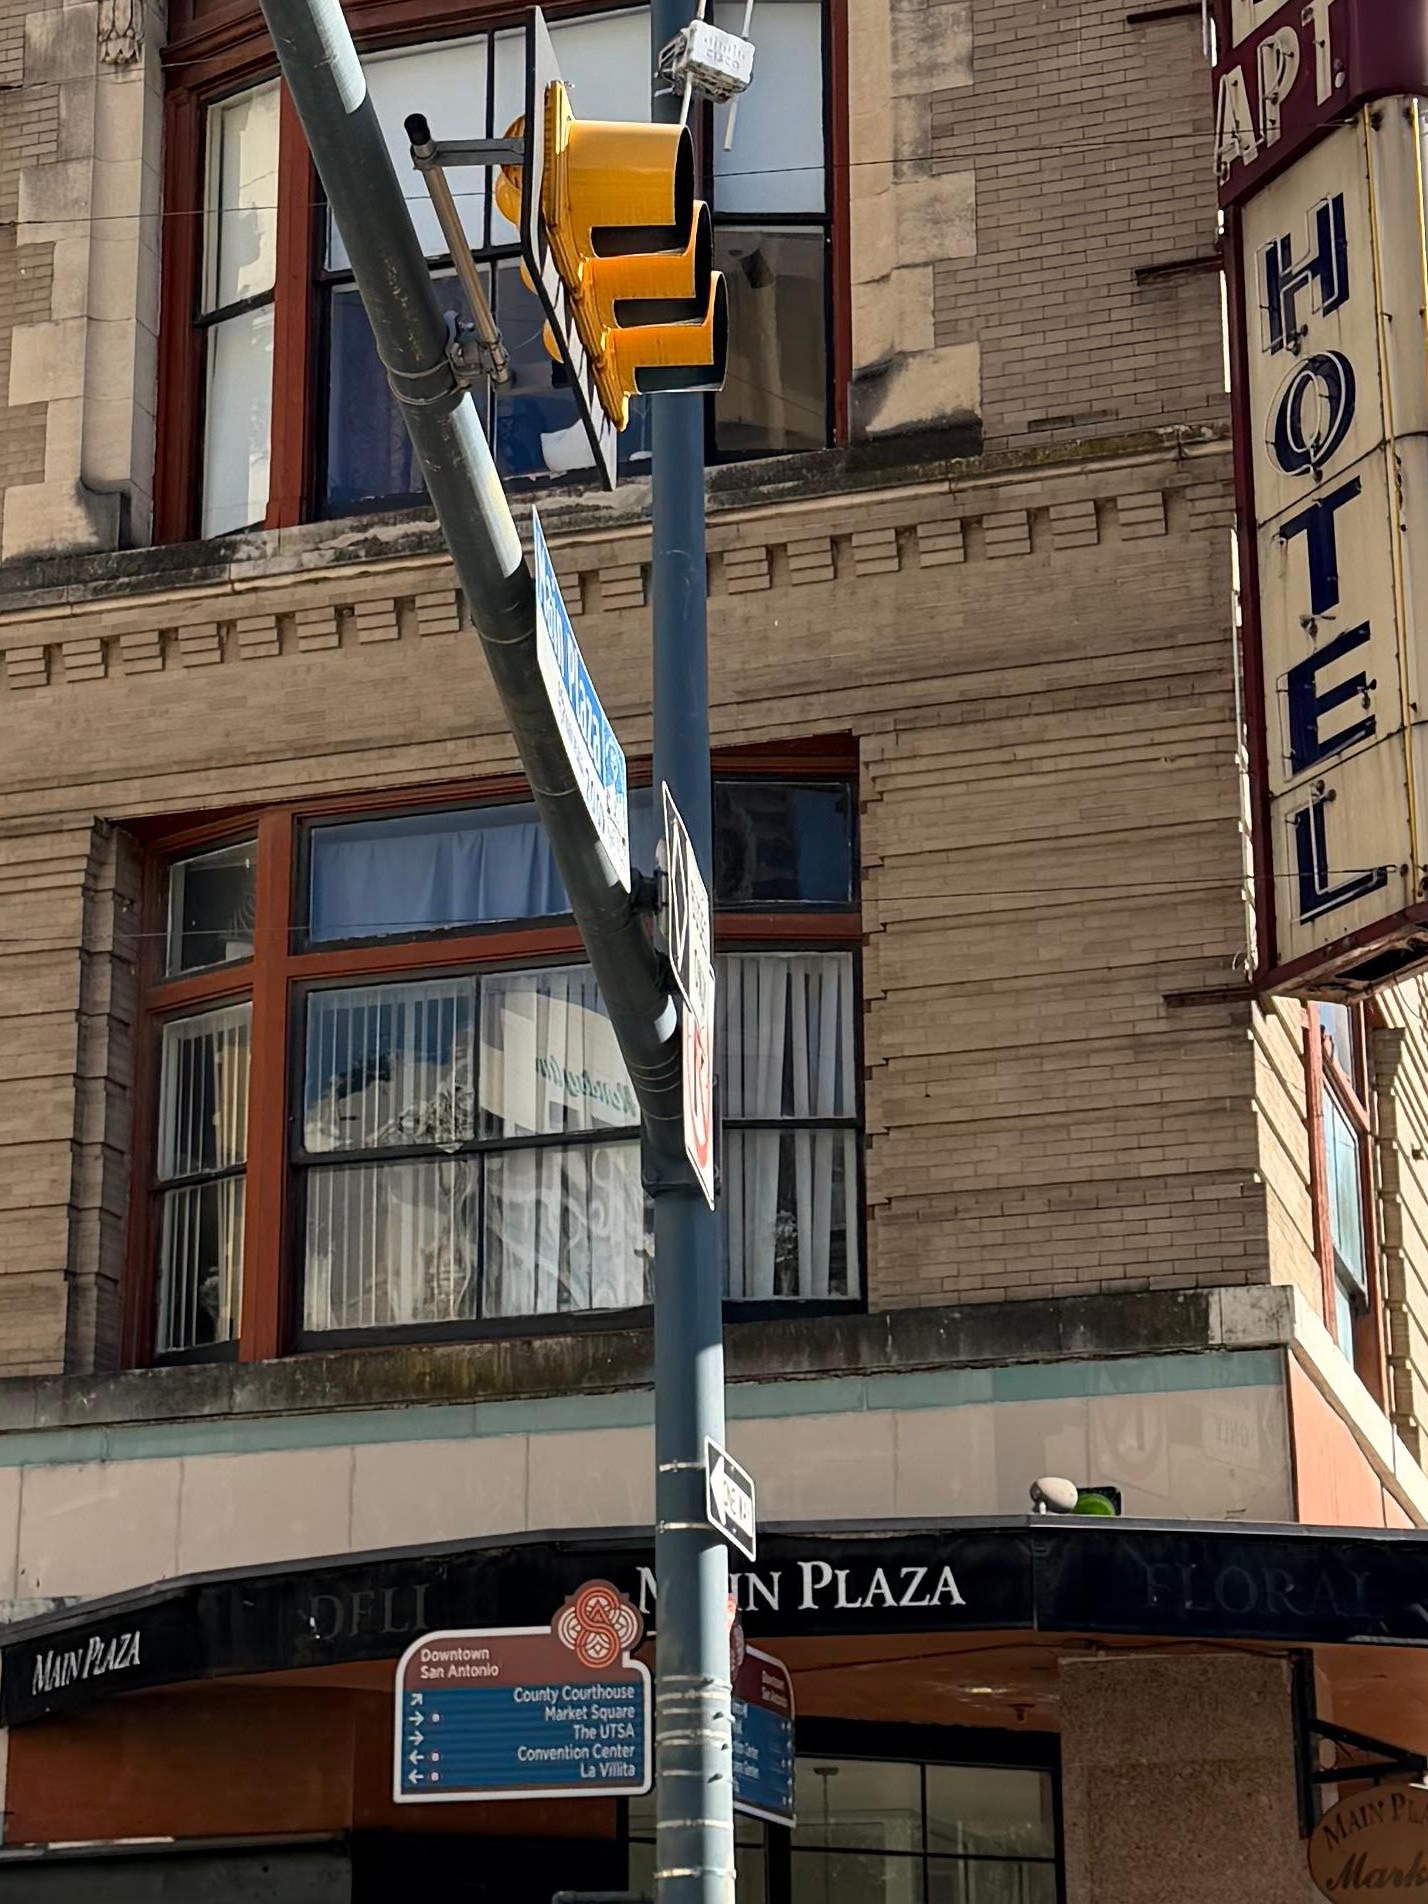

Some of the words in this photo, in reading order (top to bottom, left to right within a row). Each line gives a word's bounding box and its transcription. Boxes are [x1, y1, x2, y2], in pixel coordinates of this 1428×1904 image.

[1256, 191, 1389, 925] HOTEL
[537, 538, 564, 679] Main
[566, 632, 602, 774] Plaza
[797, 1560, 967, 1610] PLAZA
[32, 1649, 83, 1696] MAIN
[82, 1630, 141, 1679] PLAZA
[420, 1648, 490, 1663] Downtown
[420, 1665, 445, 1680] San
[452, 1663, 500, 1678] Antonio
[513, 1687, 559, 1704] County
[561, 1684, 635, 1701] Courthouse
[545, 1706, 588, 1722] Market
[591, 1704, 635, 1721] Square
[573, 1724, 598, 1740] The
[599, 1723, 635, 1739] UTSA
[517, 1746, 590, 1762] Convention
[592, 1744, 635, 1760] Center
[580, 1763, 597, 1778] La
[599, 1762, 636, 1778] Villita
[1321, 1799, 1385, 1852] MAIN
